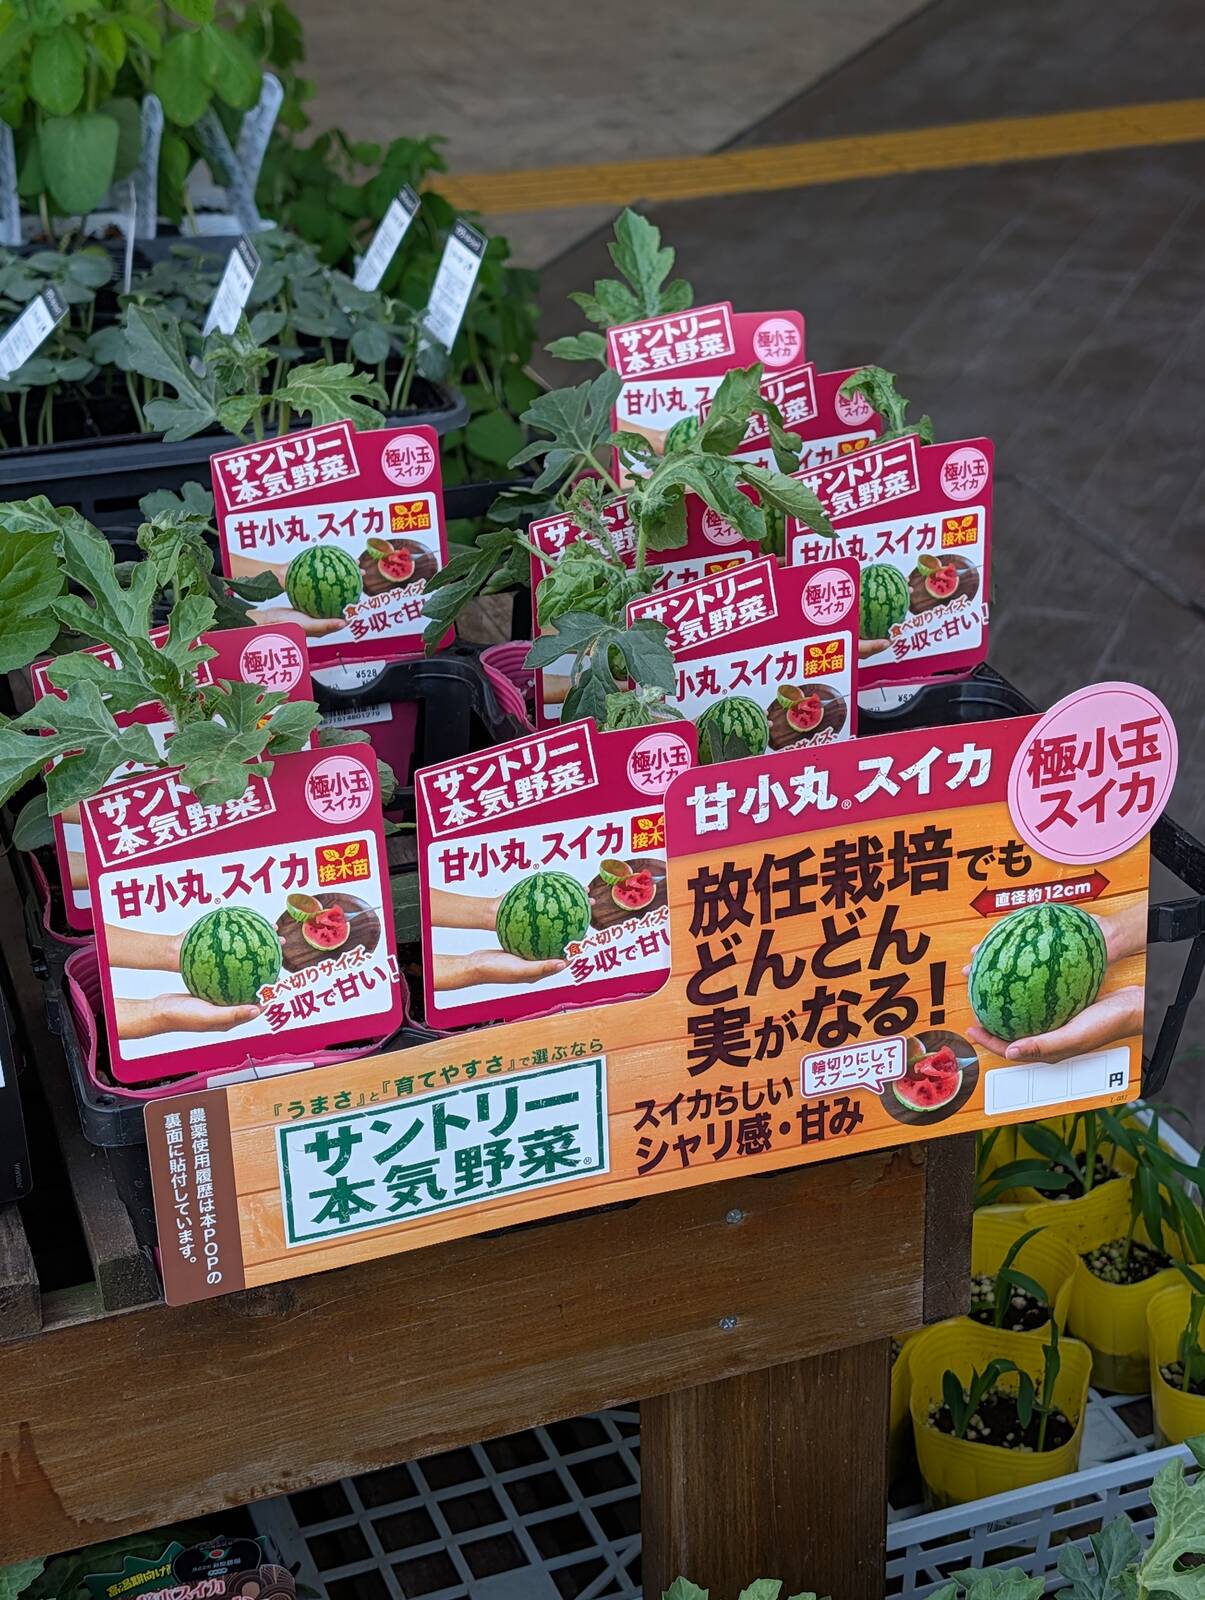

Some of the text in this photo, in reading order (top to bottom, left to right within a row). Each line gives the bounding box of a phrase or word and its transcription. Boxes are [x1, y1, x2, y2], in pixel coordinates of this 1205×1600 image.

[619, 317, 721, 353] サントリー
[623, 333, 725, 373] 本気野菜
[757, 330, 798, 347] 極小玉
[764, 349, 791, 358] スイカ
[844, 405, 869, 418] スイカ
[225, 437, 342, 481] サントリー
[385, 446, 431, 467] 極小玉
[394, 465, 426, 478] スイカ
[944, 458, 986, 482] 極小玉
[232, 454, 350, 503] 本気野菜
[821, 470, 910, 516] 気野菜
[950, 479, 979, 492] スイカ
[391, 512, 430, 532] 接木苗
[942, 528, 978, 547] 接木苗
[641, 577, 763, 623] サントリー
[806, 580, 852, 605] 極小玉
[813, 601, 845, 617] スイカ
[350, 600, 427, 641] 多収で甘
[664, 594, 767, 648] 気野菜
[243, 646, 301, 675] 極小玉
[255, 670, 293, 686] スイカ
[675, 650, 798, 702] 小丸スイカ
[805, 654, 844, 675] 接木苗
[432, 743, 580, 800] サントリー
[631, 745, 688, 773] 極小玉
[1027, 714, 1164, 789] 極小玉
[98, 777, 191, 827] サント
[308, 774, 371, 802] 極小玉
[322, 794, 363, 814] スイカ
[440, 762, 587, 827] 本気野菜
[1035, 772, 1156, 835] スイカ
[107, 784, 262, 856] 本気野菜
[632, 827, 664, 851] 接木
[318, 857, 370, 884] 接木苗
[687, 824, 1033, 938] 放任栽培でも
[994, 881, 1092, 908] 直径約12cm
[686, 904, 931, 1007] どんどん
[264, 957, 401, 1032] 多収で甘い！
[686, 960, 948, 1077] 実がなる！
[272, 1037, 605, 1120] 『うまさ』と『育てやすさ』で選ぶなら
[811, 1045, 898, 1075] 輪切りにして
[813, 1060, 894, 1089] スプーンで！
[1108, 1071, 1124, 1088] 円
[632, 1076, 795, 1132] スイカらしい
[303, 1086, 580, 1177] サントリー
[635, 1096, 865, 1176] シャリ感・甘み
[163, 1112, 197, 1264] 裏面に貼付しています。
[308, 1123, 582, 1225] 本気野菜
[189, 1107, 223, 1285] 農薬使用履歴は本POPの
